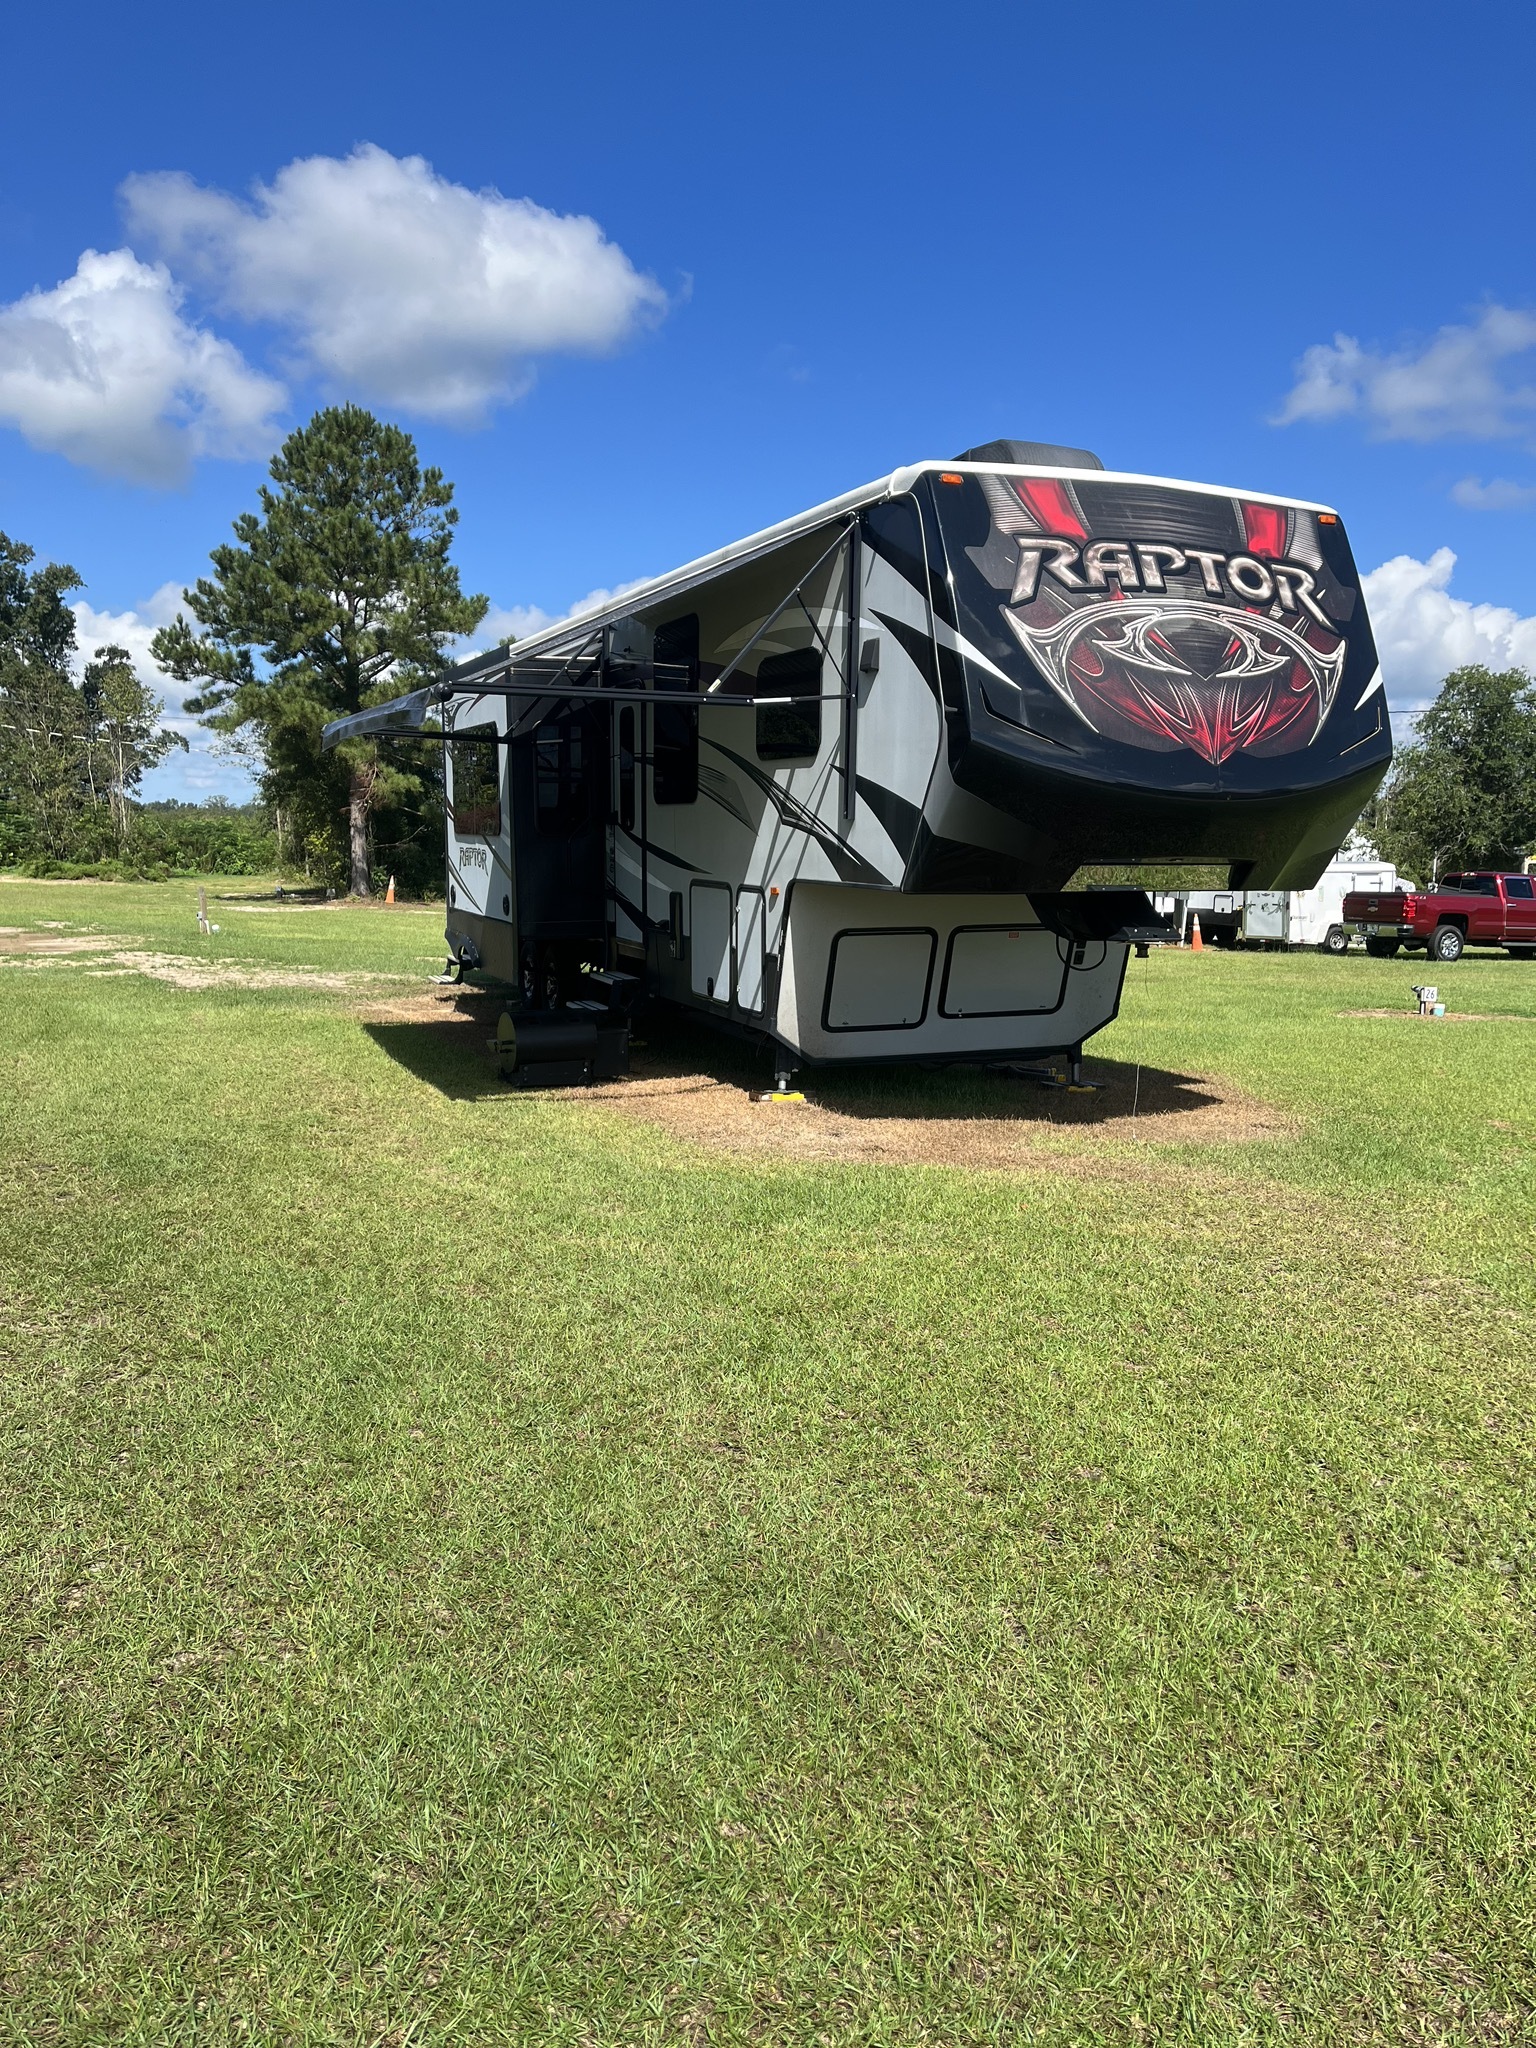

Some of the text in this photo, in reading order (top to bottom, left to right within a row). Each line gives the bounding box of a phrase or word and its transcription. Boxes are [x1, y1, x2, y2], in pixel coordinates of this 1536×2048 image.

[1010, 535, 1339, 633] RAPTOR
[459, 846, 489, 877] RAPTOR
[1425, 989, 1435, 999] 26
